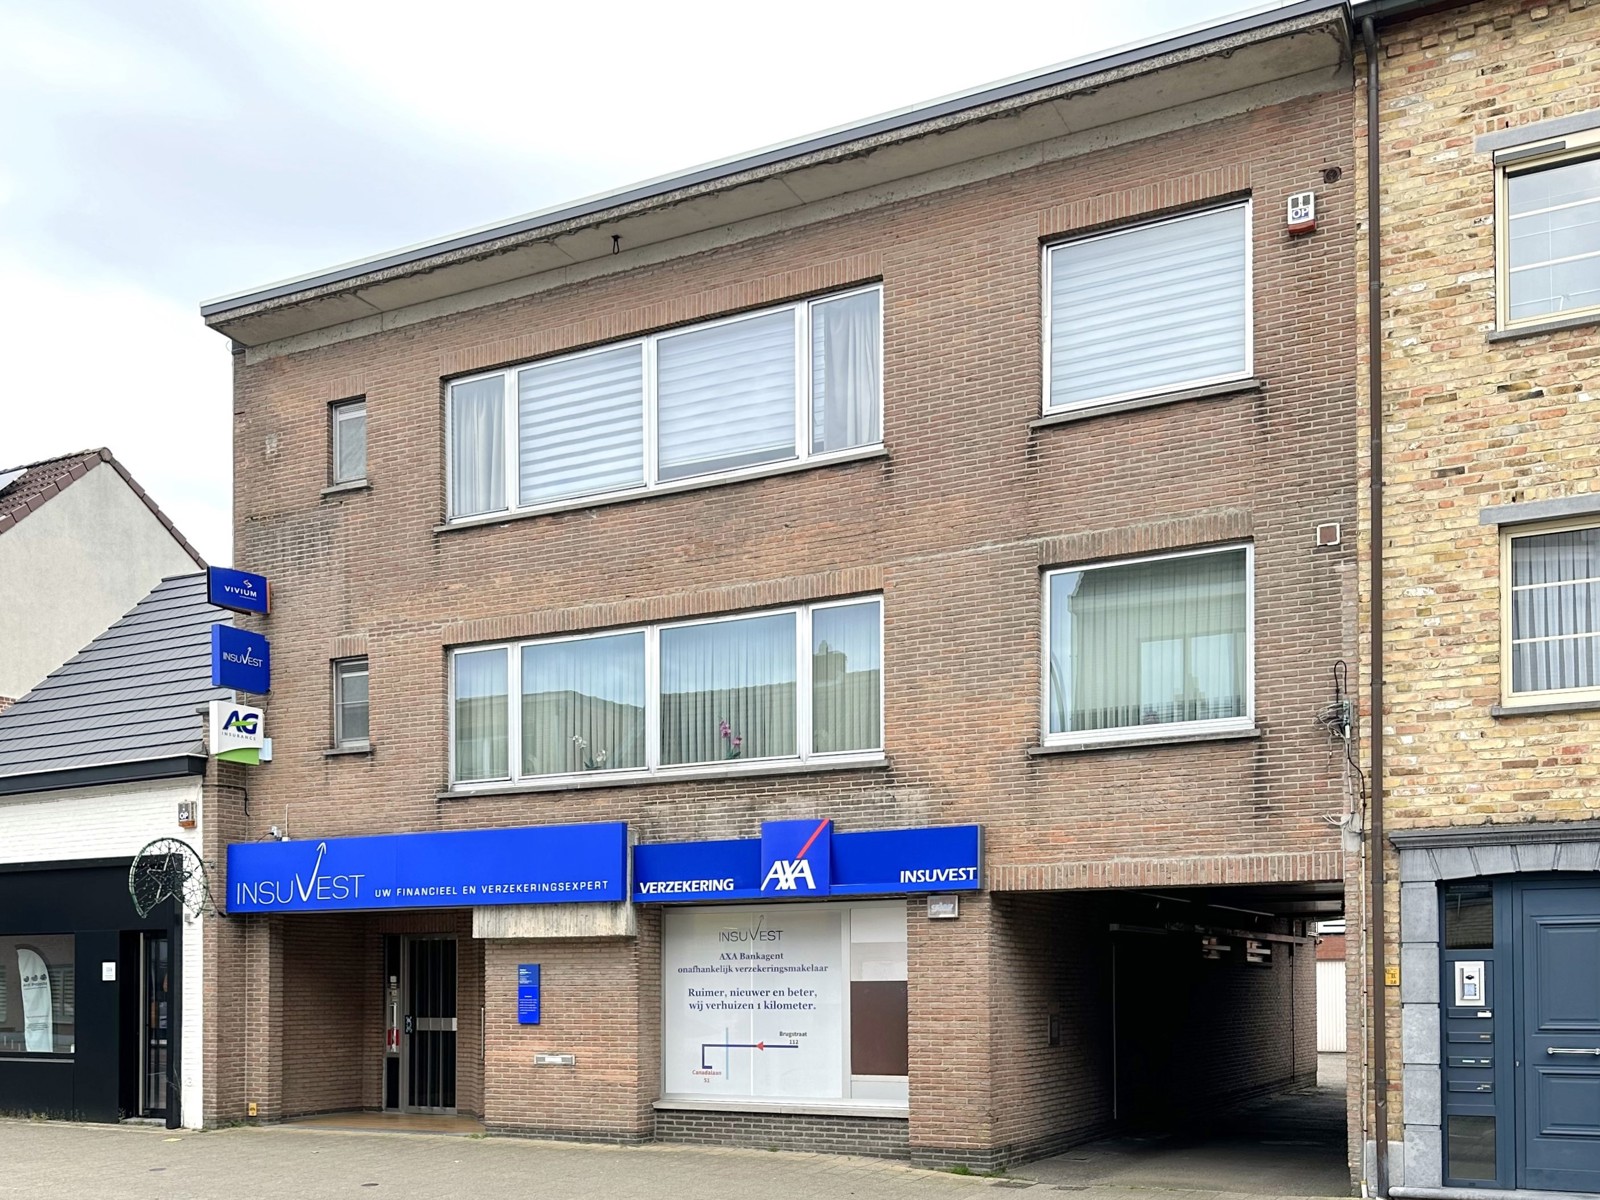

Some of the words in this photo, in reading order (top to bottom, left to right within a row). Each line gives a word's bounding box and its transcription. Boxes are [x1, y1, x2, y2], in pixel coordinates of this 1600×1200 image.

[224, 585, 257, 597] VIVIUM
[222, 649, 263, 667] INSUVEST
[222, 710, 259, 735] AG
[221, 731, 256, 741] INSURANCE
[236, 854, 365, 905] INSUVEST
[760, 858, 817, 891] AXA
[900, 866, 978, 884] INSUVEST
[374, 888, 392, 898] UW
[396, 885, 458, 897] FINANCIEEL
[462, 885, 476, 895] EN
[481, 879, 609, 894] VERZEKERINGSEXPERT
[639, 877, 735, 895] VERZEKERING
[718, 920, 784, 942] INSUVEST
[719, 952, 738, 961] AXA
[739, 952, 784, 962] Bankagent
[677, 965, 733, 975] onafhankelijk
[735, 963, 829, 975] verzekeringsmakelaar
[688, 988, 727, 998] Ruimer,
[730, 988, 770, 997] nieuwer
[787, 987, 818, 998] beter,
[689, 1001, 704, 1012] wij
[705, 1001, 754, 1010] verhuizen
[763, 1000, 817, 1010] kilometer.
